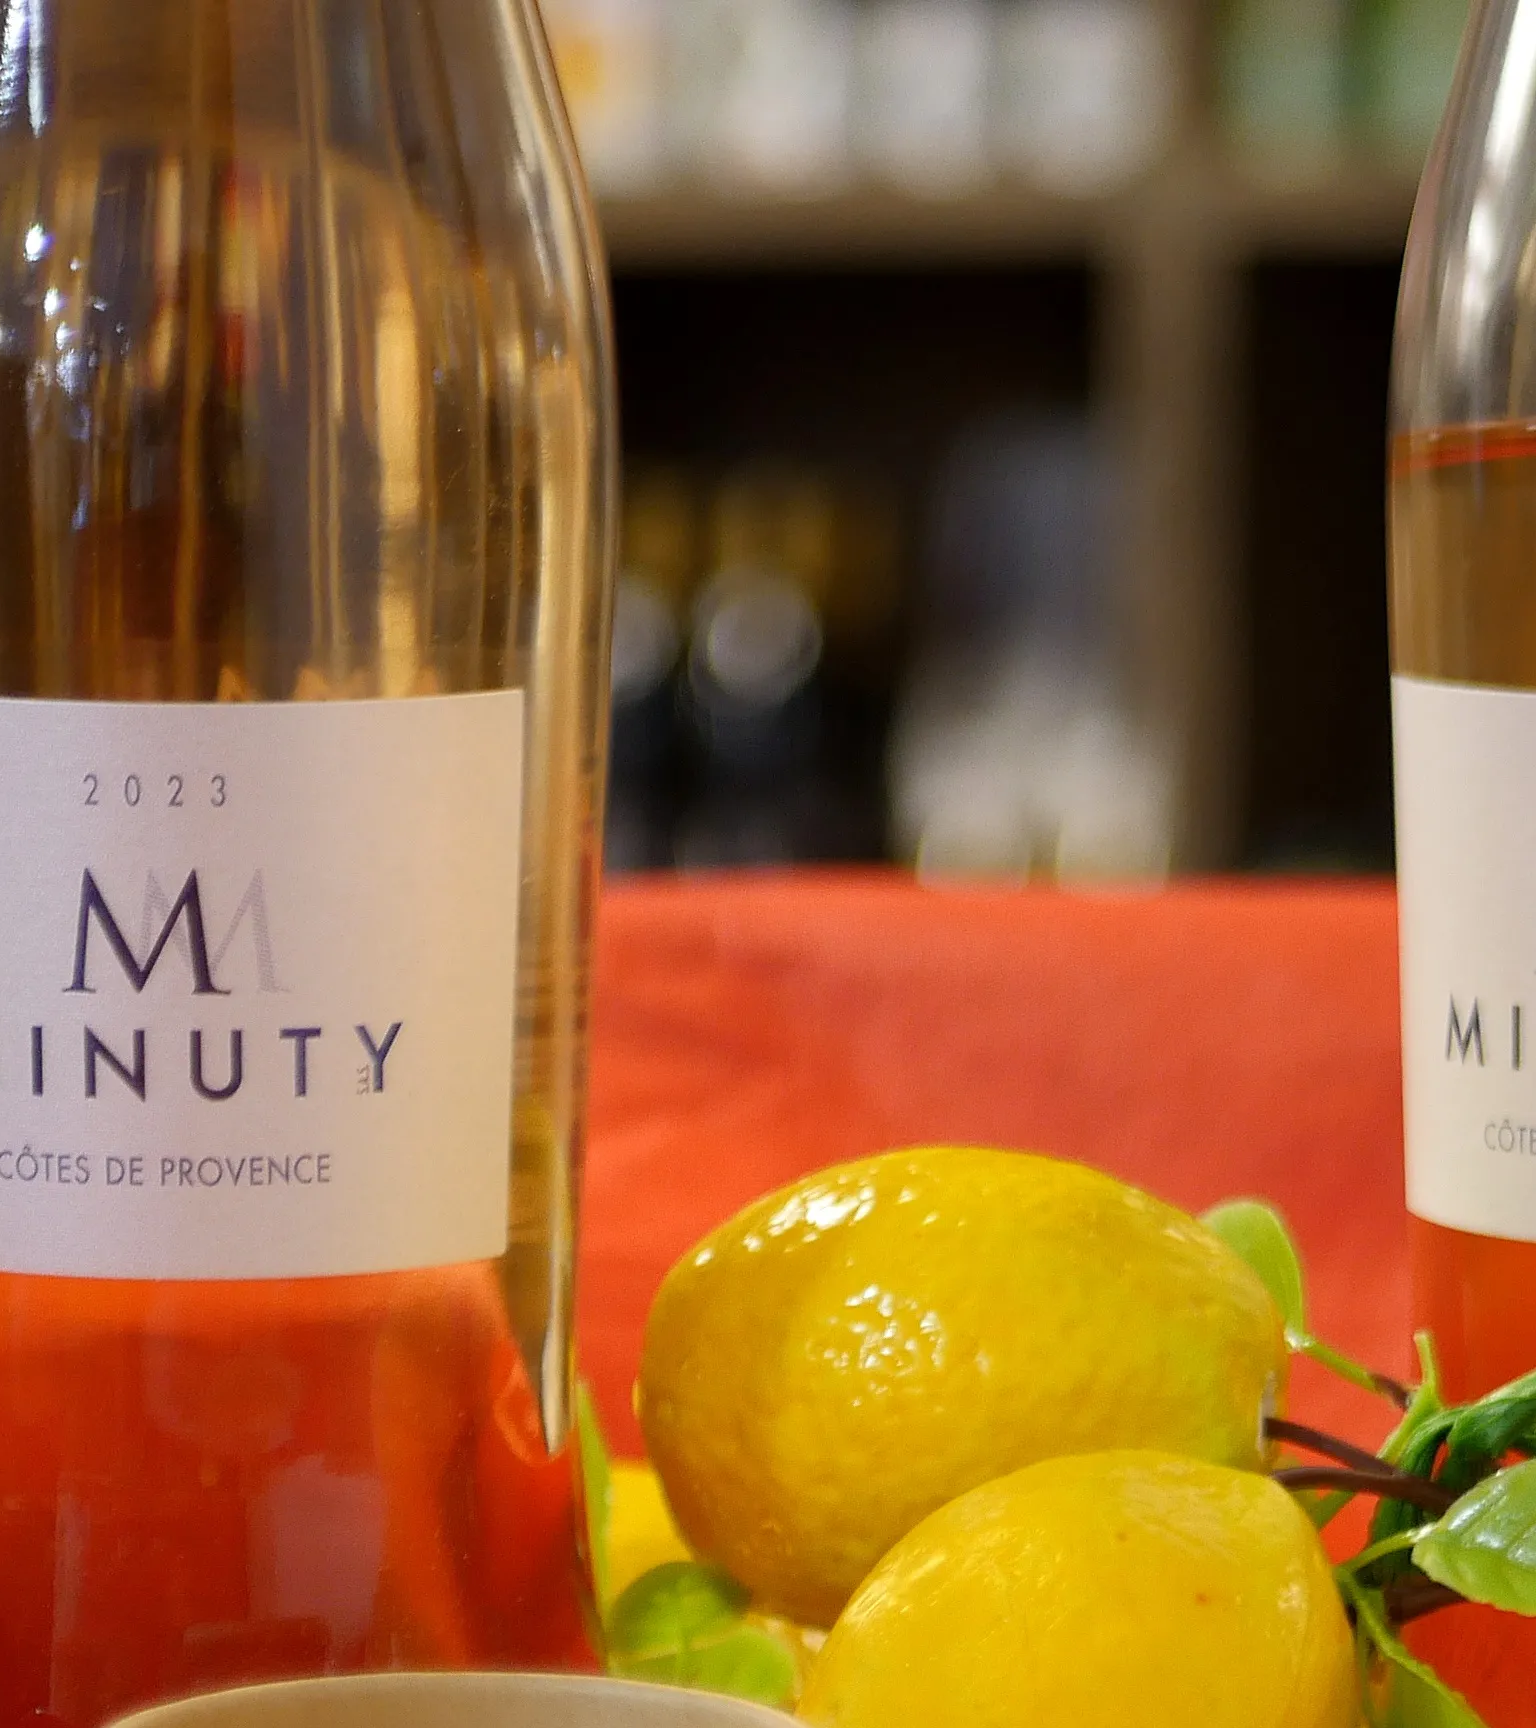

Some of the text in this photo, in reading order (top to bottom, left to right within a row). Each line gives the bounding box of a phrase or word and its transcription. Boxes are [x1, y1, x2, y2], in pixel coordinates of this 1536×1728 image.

[82, 771, 228, 808] 2023
[105, 1155, 145, 1187] DE
[159, 1152, 331, 1188] PROVENCE
